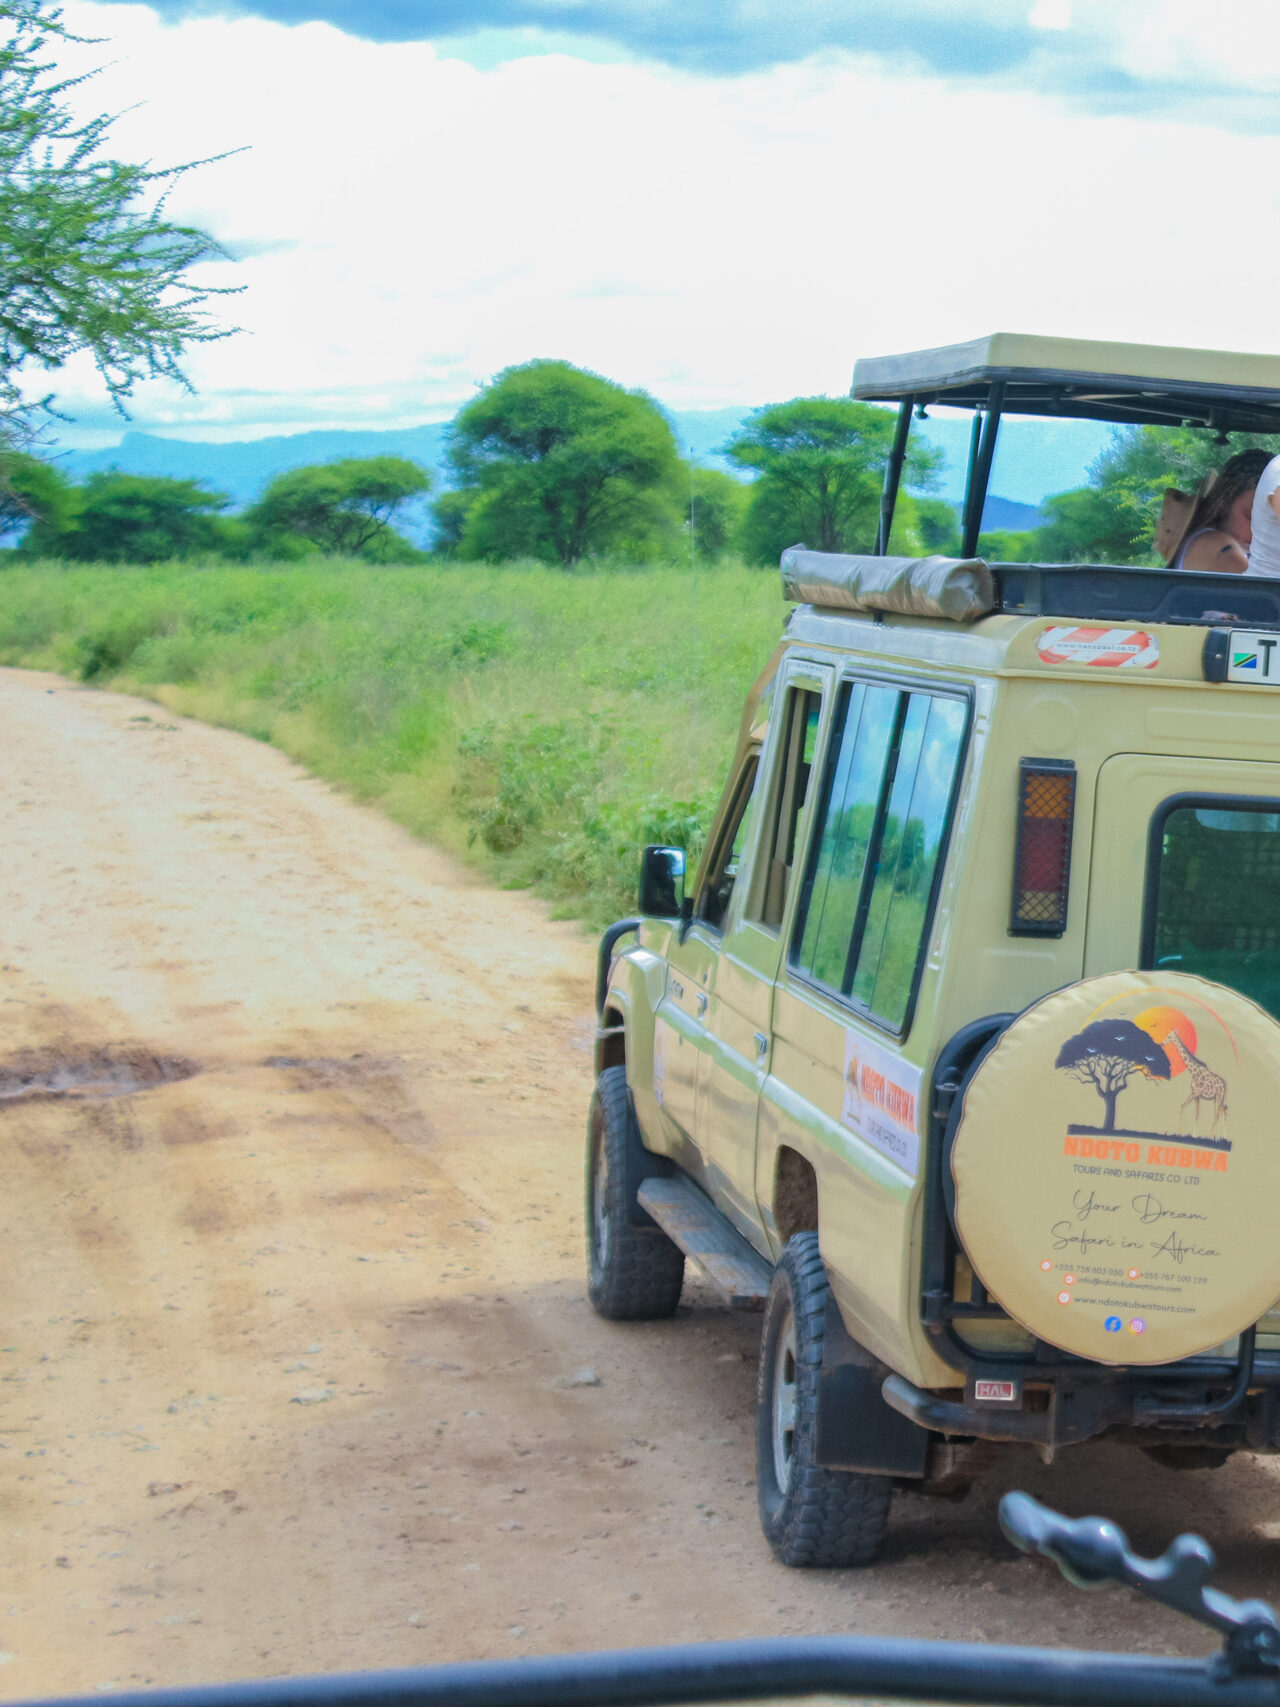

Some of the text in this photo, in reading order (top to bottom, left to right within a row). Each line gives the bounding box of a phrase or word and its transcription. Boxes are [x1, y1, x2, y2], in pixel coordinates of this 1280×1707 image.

[1257, 639, 1278, 677] T
[1063, 1136, 1228, 1172] NDOTO KUBWA
[1073, 1165, 1101, 1176] TOURS
[1103, 1167, 1122, 1178] AND
[1124, 1169, 1164, 1182] SAFARIS
[1184, 1175, 1200, 1186] LTD
[1072, 1188, 1208, 1224] Your Dream
[1051, 1221, 1220, 1264] Safari in Africa
[1074, 1296, 1196, 1314] www.ndotokubwatours.com
[980, 1384, 1010, 1397] HAL
